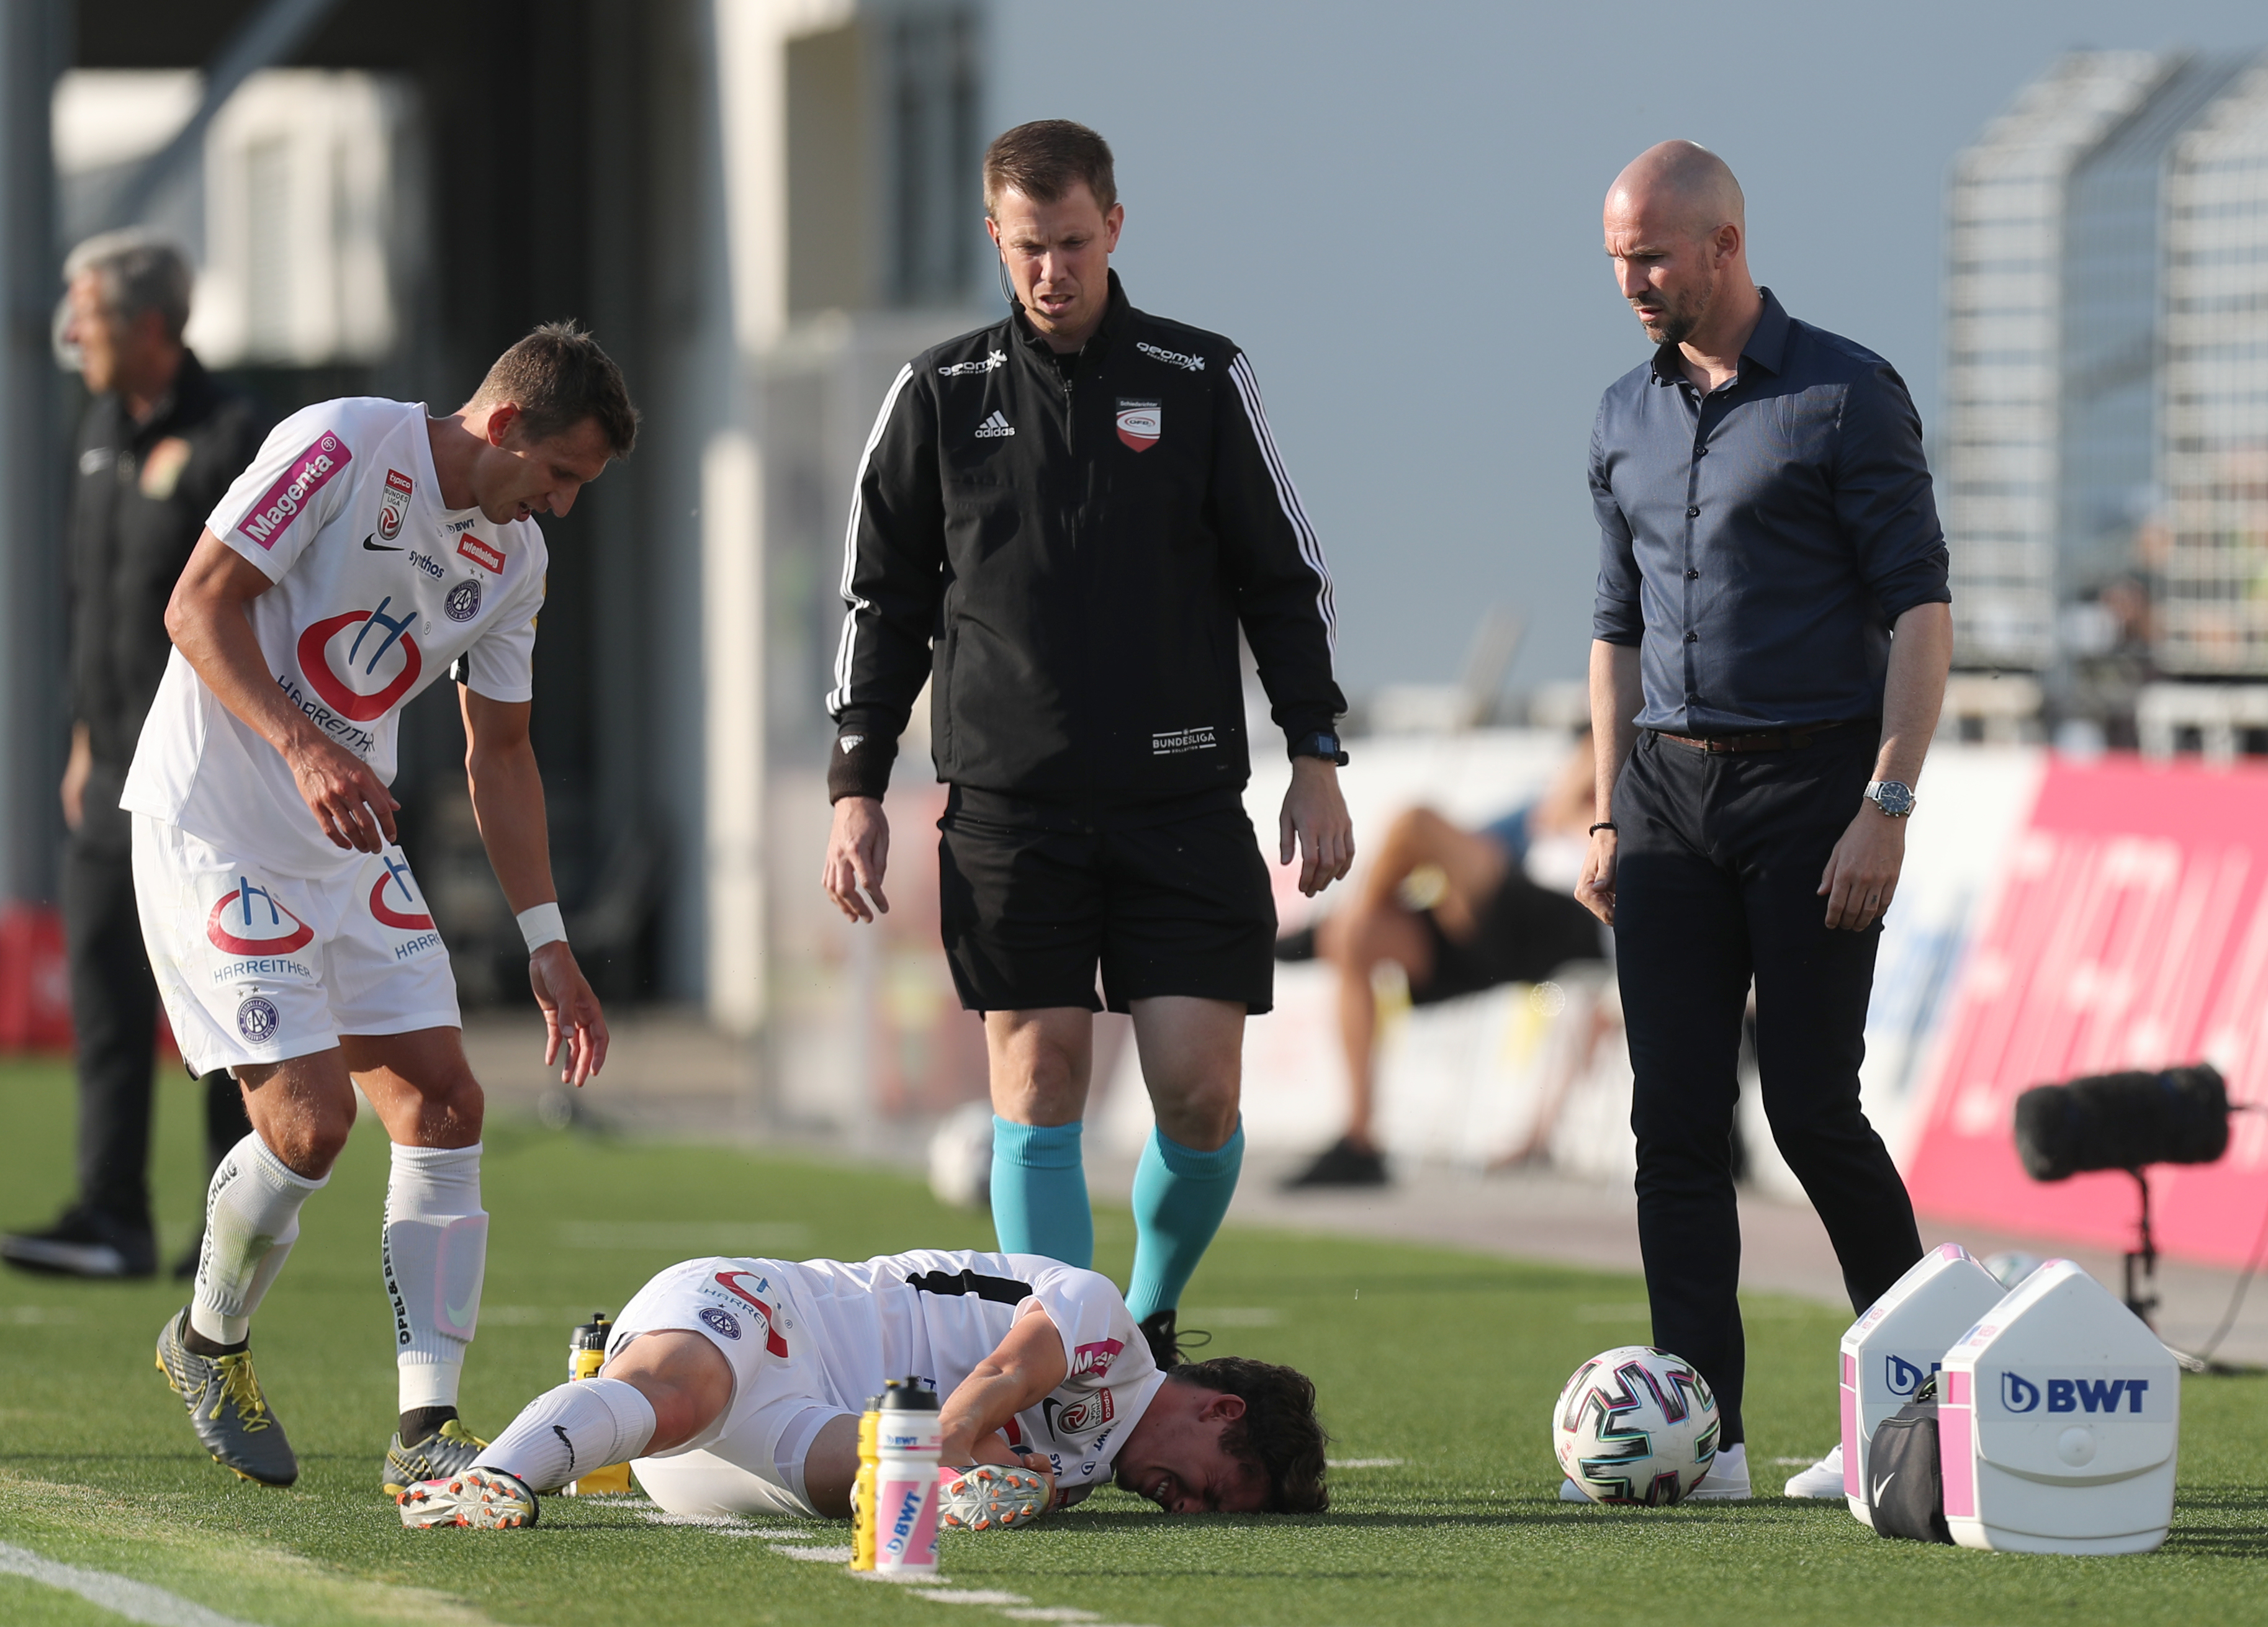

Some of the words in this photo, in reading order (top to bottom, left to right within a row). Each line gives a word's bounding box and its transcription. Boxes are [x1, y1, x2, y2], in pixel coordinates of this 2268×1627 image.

[975, 426, 1015, 439] adidas
[389, 473, 411, 489] tipico
[246, 454, 335, 542] Magenta
[385, 487, 408, 503] BUNDES
[387, 496, 400, 506] LIGA
[454, 518, 475, 532] BWT
[408, 550, 445, 578] synthos
[1153, 732, 1216, 749] BUNDESLIGA
[214, 959, 313, 984] HARREITHER
[389, 1278, 398, 1295] &
[394, 1296, 412, 1345] OPEL
[2048, 1379, 2149, 1414] BWT
[894, 1436, 919, 1445] BWT
[893, 1490, 922, 1537] BWT
